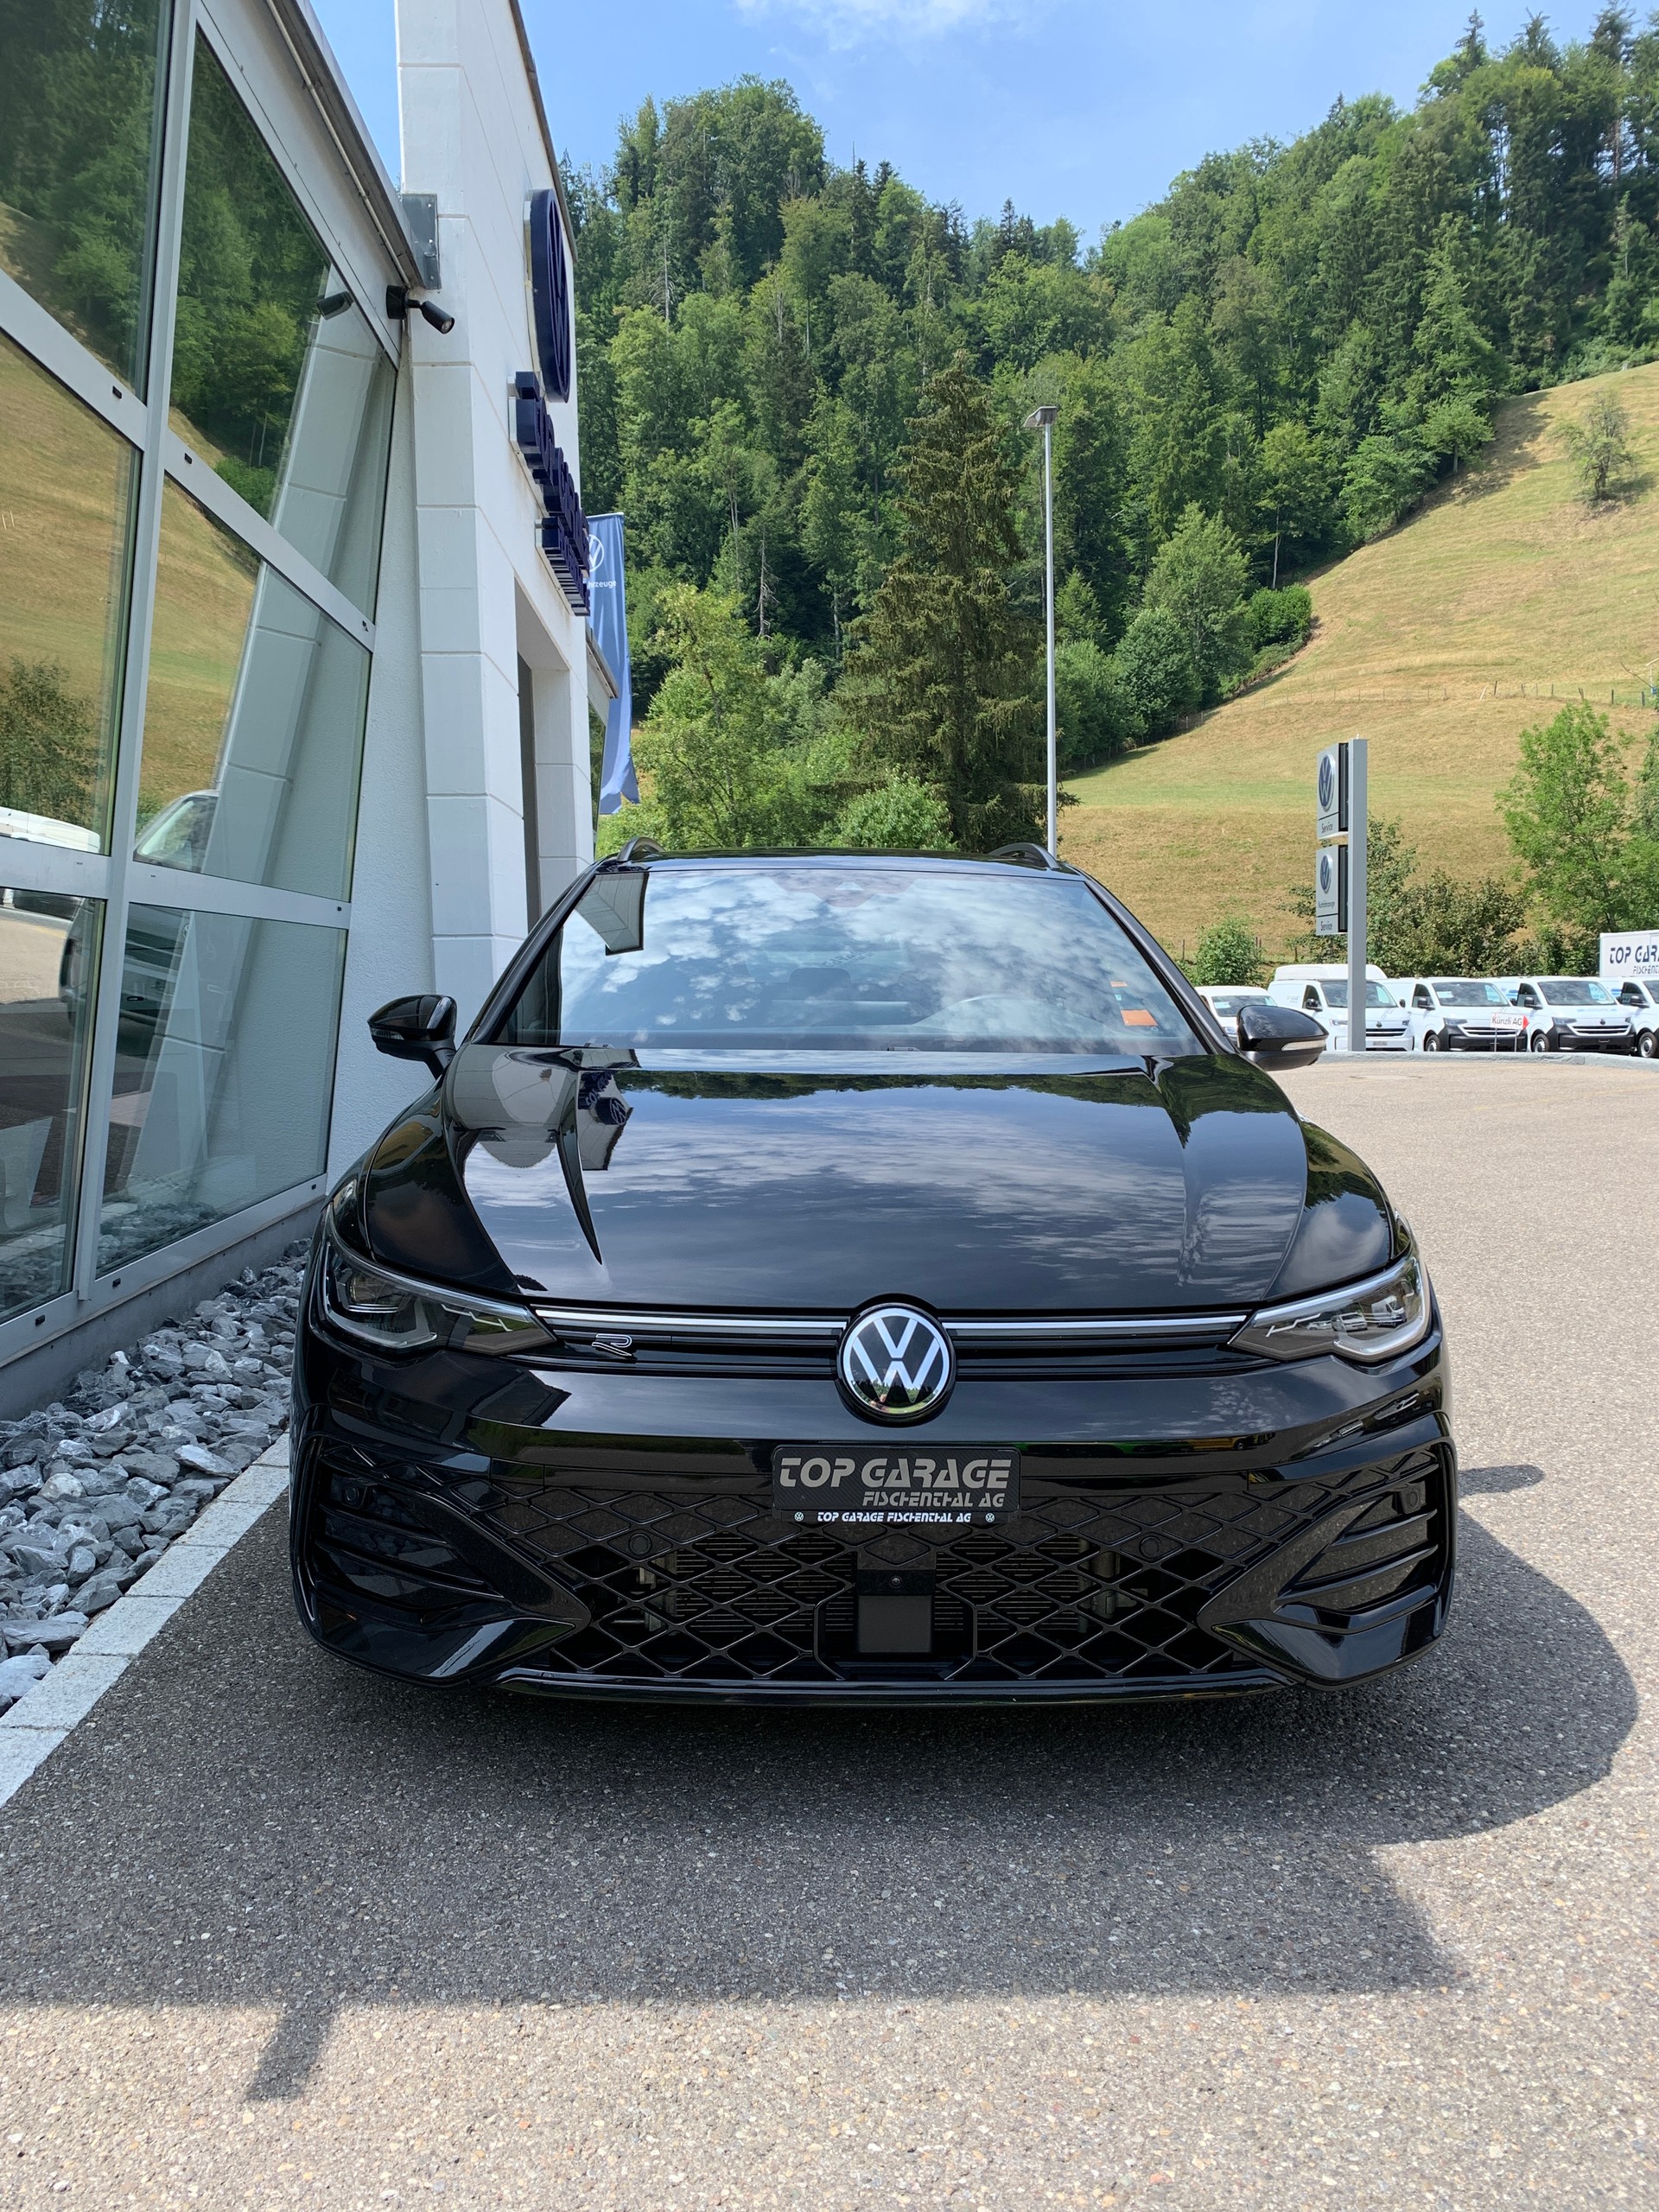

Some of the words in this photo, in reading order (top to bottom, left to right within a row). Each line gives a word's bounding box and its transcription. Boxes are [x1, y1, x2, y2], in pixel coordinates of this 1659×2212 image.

[1321, 822, 1333, 834] Service
[1320, 920, 1332, 931] Service
[1610, 946, 1631, 964] TOP
[1491, 1016, 1511, 1026] Künzli
[1513, 1018, 1522, 1027] AG
[842, 1307, 950, 1414] VW
[779, 1457, 856, 1488] TOP
[861, 1458, 1013, 1489] GARAGE
[862, 1491, 974, 1508] FISCHENTHAL
[978, 1492, 1006, 1508] AG
[817, 1511, 840, 1522] TOP
[842, 1511, 885, 1522] GARAGE
[887, 1512, 953, 1522] FISCHENTHAL
[956, 1512, 972, 1522] AG
